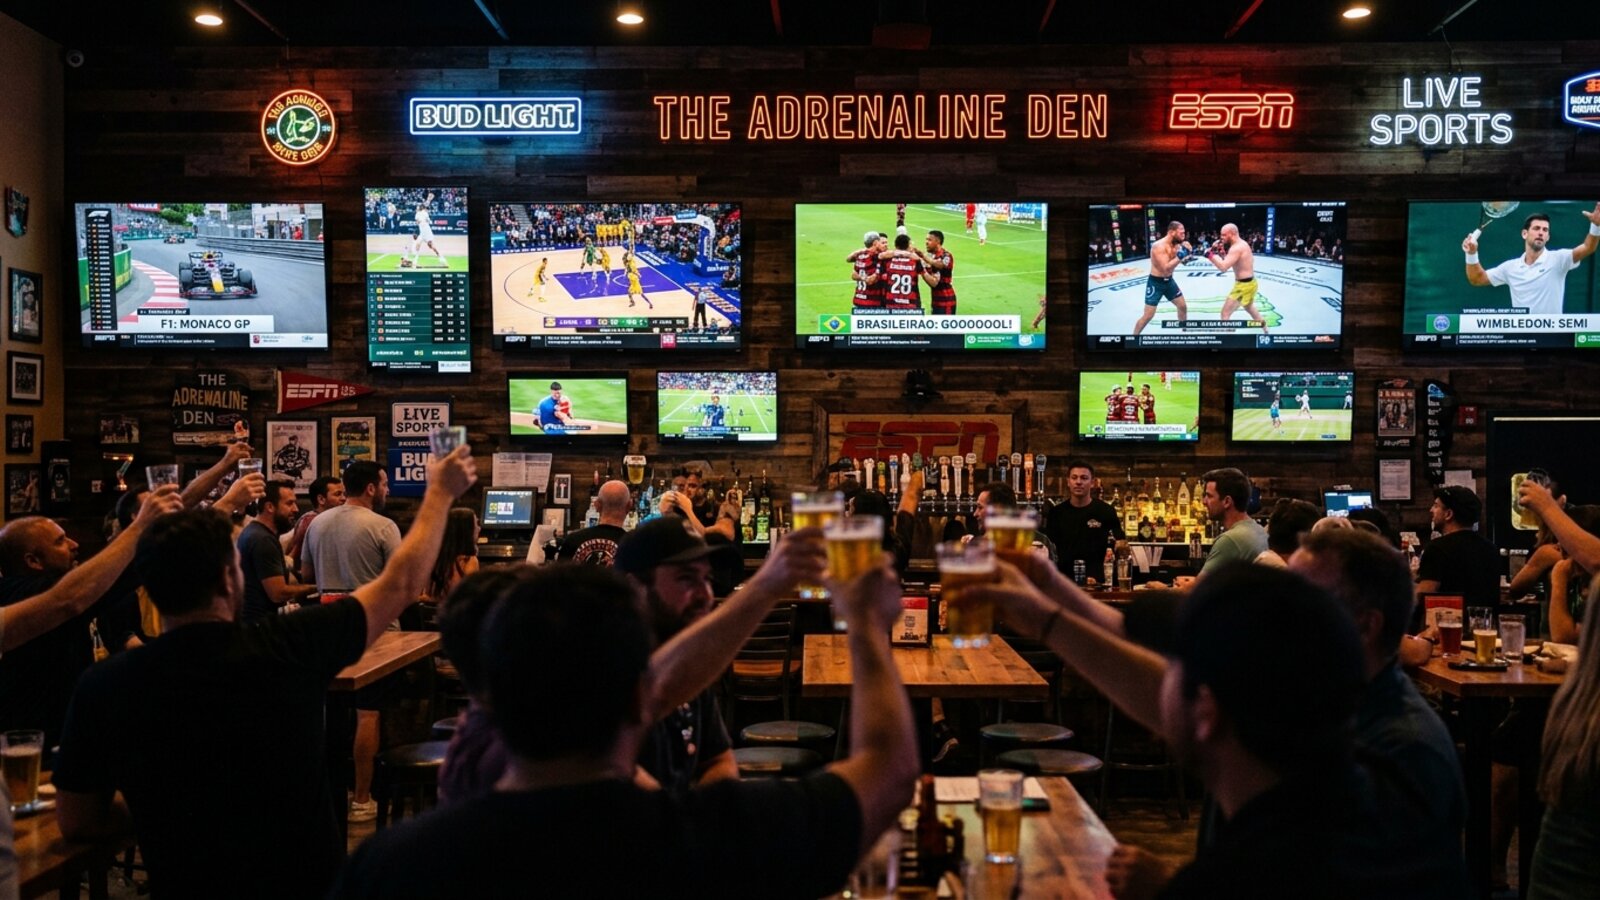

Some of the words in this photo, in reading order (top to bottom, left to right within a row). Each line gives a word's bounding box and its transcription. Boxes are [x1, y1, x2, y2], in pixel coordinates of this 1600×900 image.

[1403, 76, 1482, 108] LIVE
[415, 104, 481, 128] BUD
[653, 96, 731, 140] THE
[748, 95, 1007, 139] ADRENALINE
[1028, 94, 1108, 138] DEN
[1169, 93, 1294, 129] ESPN
[1369, 113, 1513, 145] SPORTS
[890, 273, 912, 295] 28
[160, 319, 177, 329] F1:
[179, 319, 232, 329] MONACO
[234, 319, 251, 329] GP
[1476, 319, 1555, 329] WIMBLEDON:
[1558, 319, 1588, 329] SEMI
[198, 374, 226, 386] THE
[286, 384, 338, 398] ESPN
[183, 410, 214, 425] DEN
[403, 408, 440, 421] LIVE
[840, 421, 999, 463] ESPN
[401, 452, 431, 467] BU
[395, 467, 425, 481] LIG
